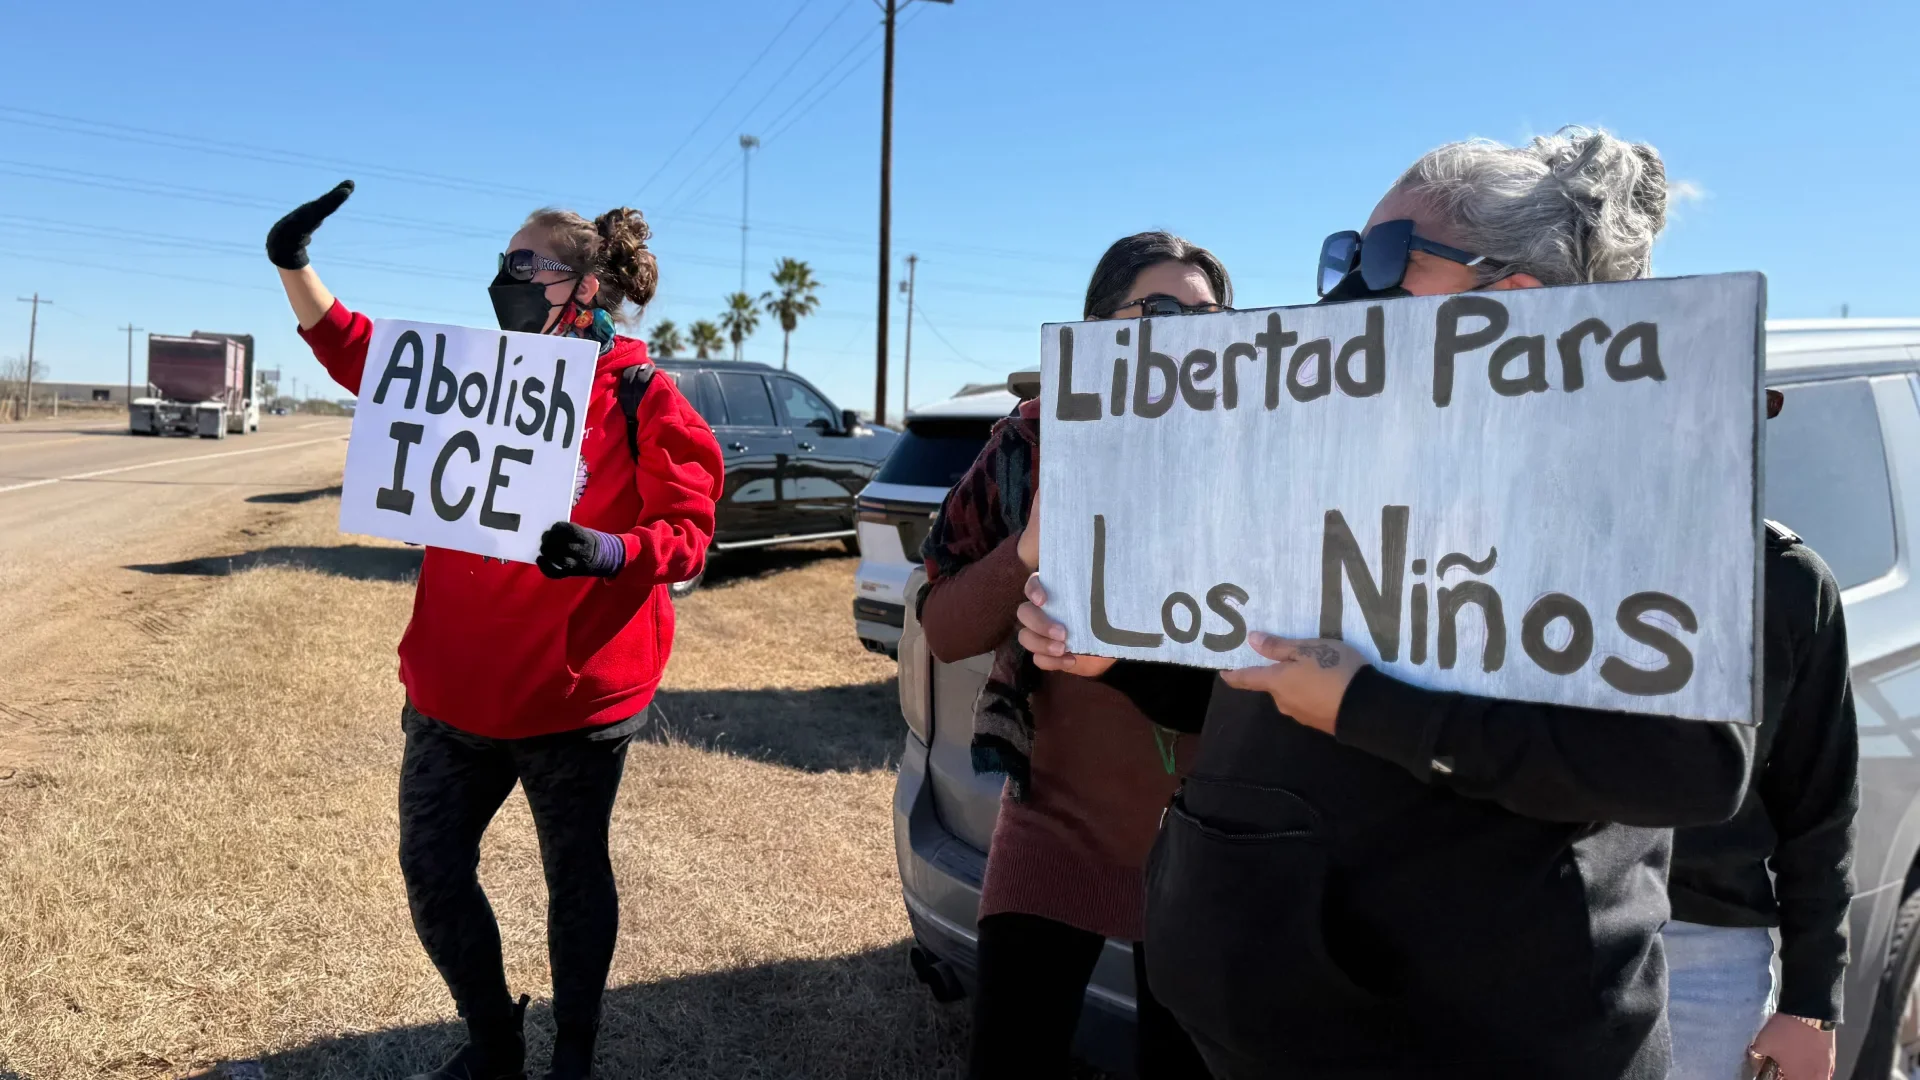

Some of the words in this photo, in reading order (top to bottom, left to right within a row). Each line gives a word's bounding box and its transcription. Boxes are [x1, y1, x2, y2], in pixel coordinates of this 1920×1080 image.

[373, 330, 576, 449] Abolish
[1056, 305, 1386, 422] Libertad
[1433, 296, 1666, 407] Para
[376, 421, 534, 533] ICE
[1090, 514, 1250, 652] Los
[1318, 505, 1698, 696] Niños
